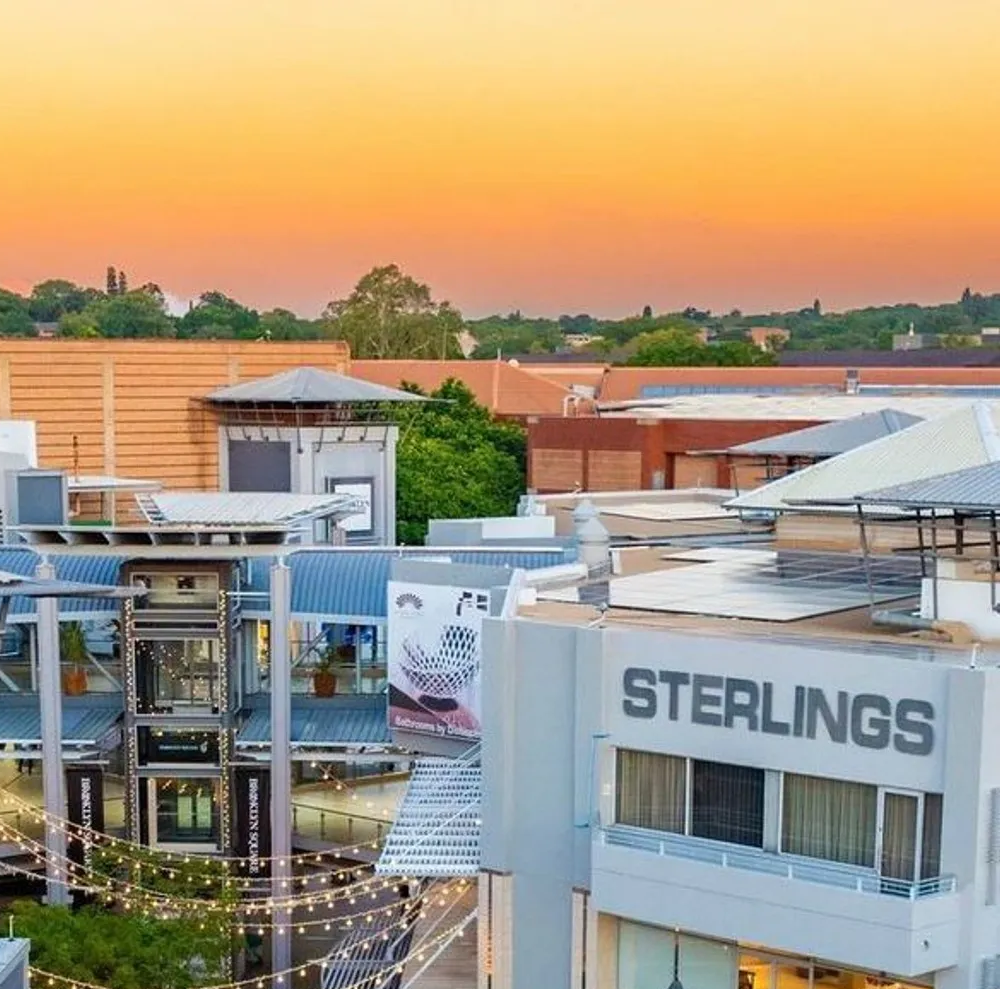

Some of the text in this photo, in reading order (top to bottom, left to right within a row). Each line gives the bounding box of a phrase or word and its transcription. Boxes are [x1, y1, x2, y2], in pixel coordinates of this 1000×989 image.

[622, 666, 936, 757] STERLINGS
[247, 777, 260, 874] BROOKLYN SQUARE
